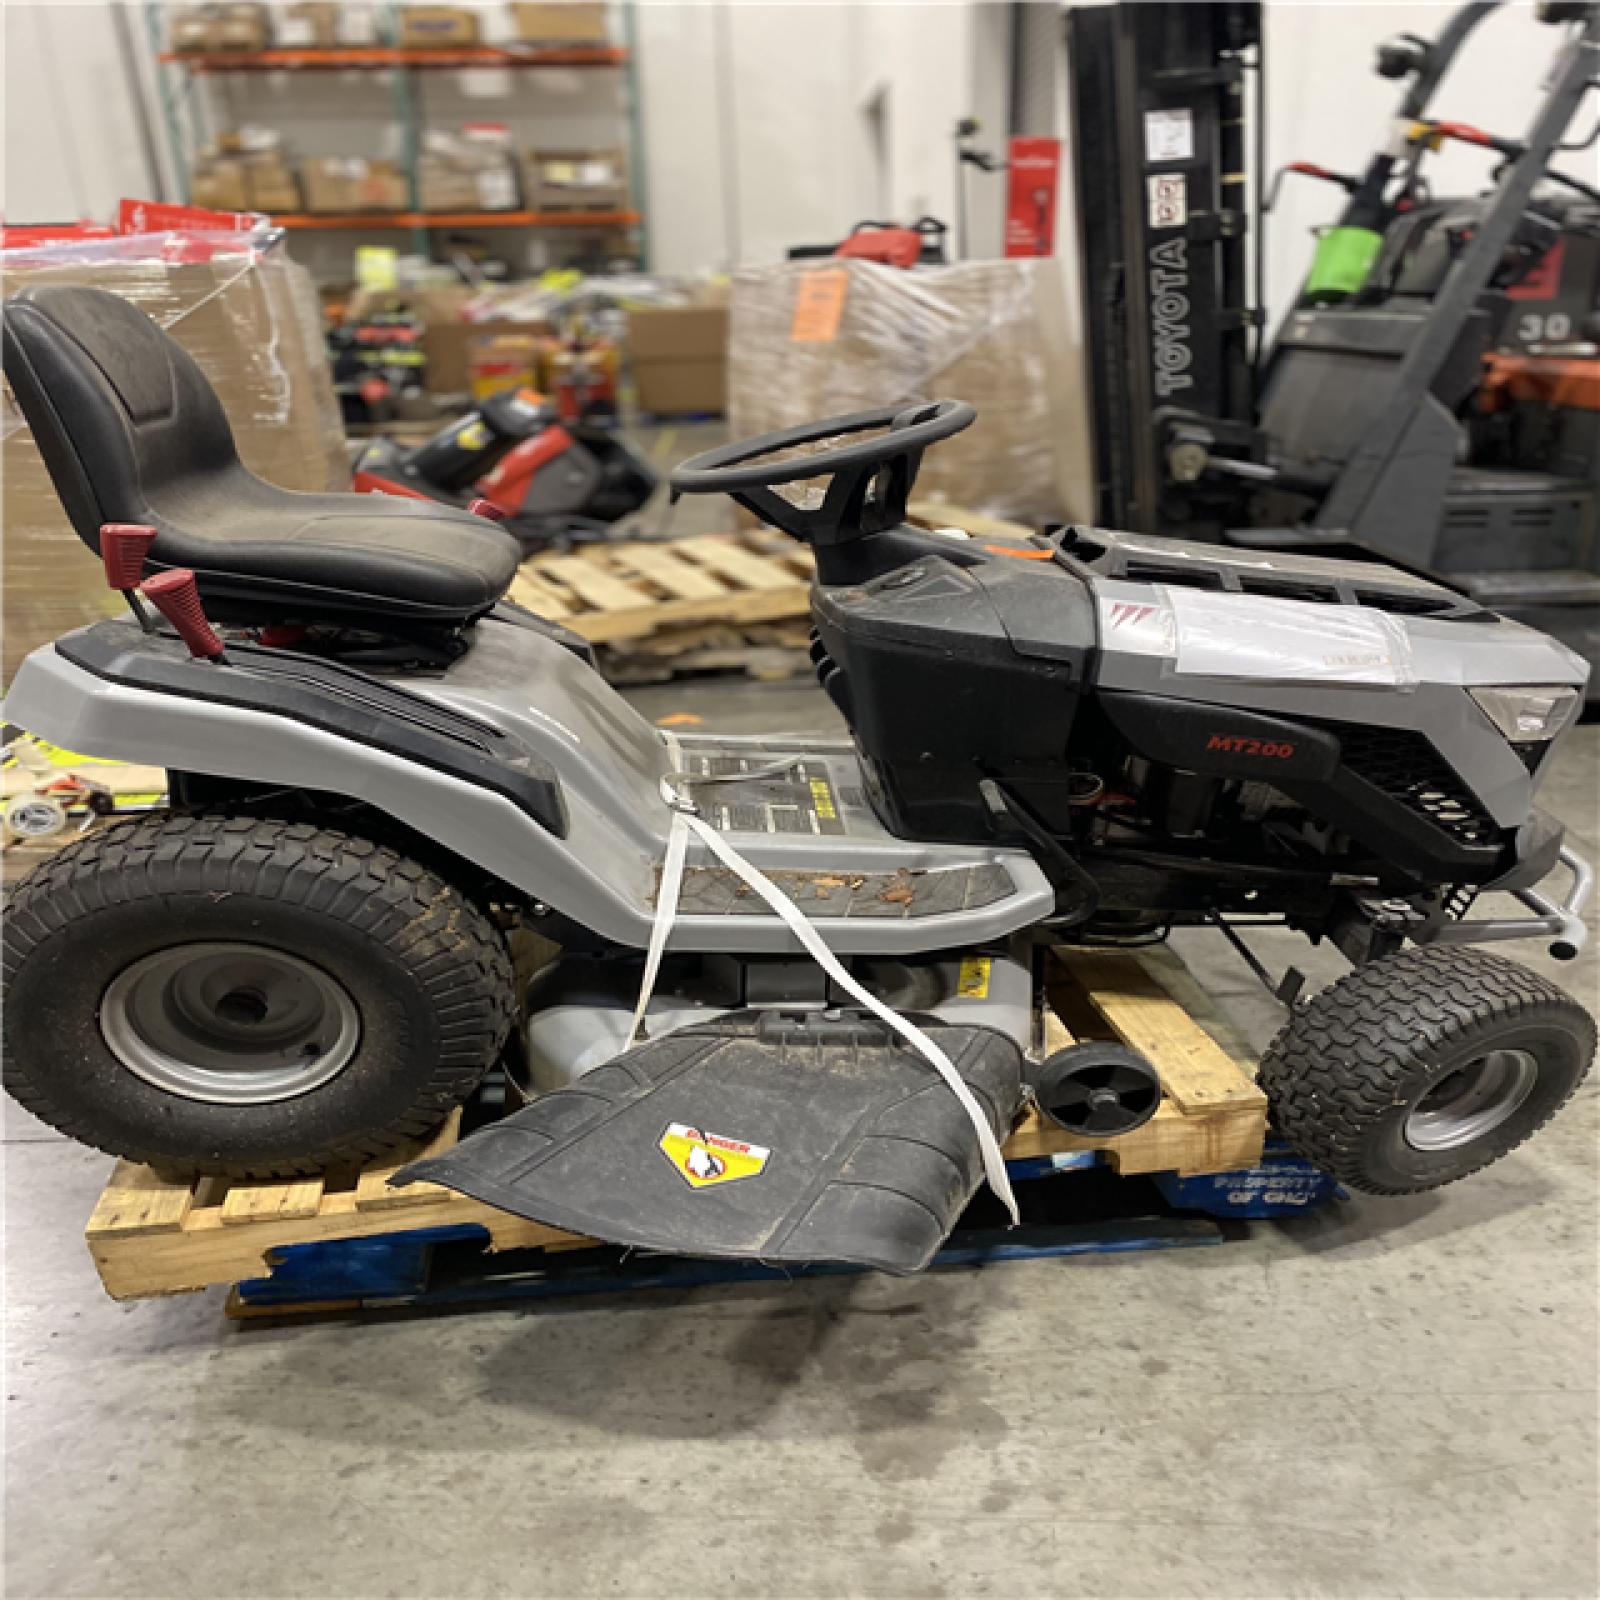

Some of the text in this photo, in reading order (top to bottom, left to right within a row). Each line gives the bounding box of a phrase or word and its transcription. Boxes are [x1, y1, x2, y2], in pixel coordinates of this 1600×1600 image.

[1150, 237, 1193, 397] TOYOTA
[1517, 313, 1572, 341] 30
[1206, 735, 1294, 759] MT200
